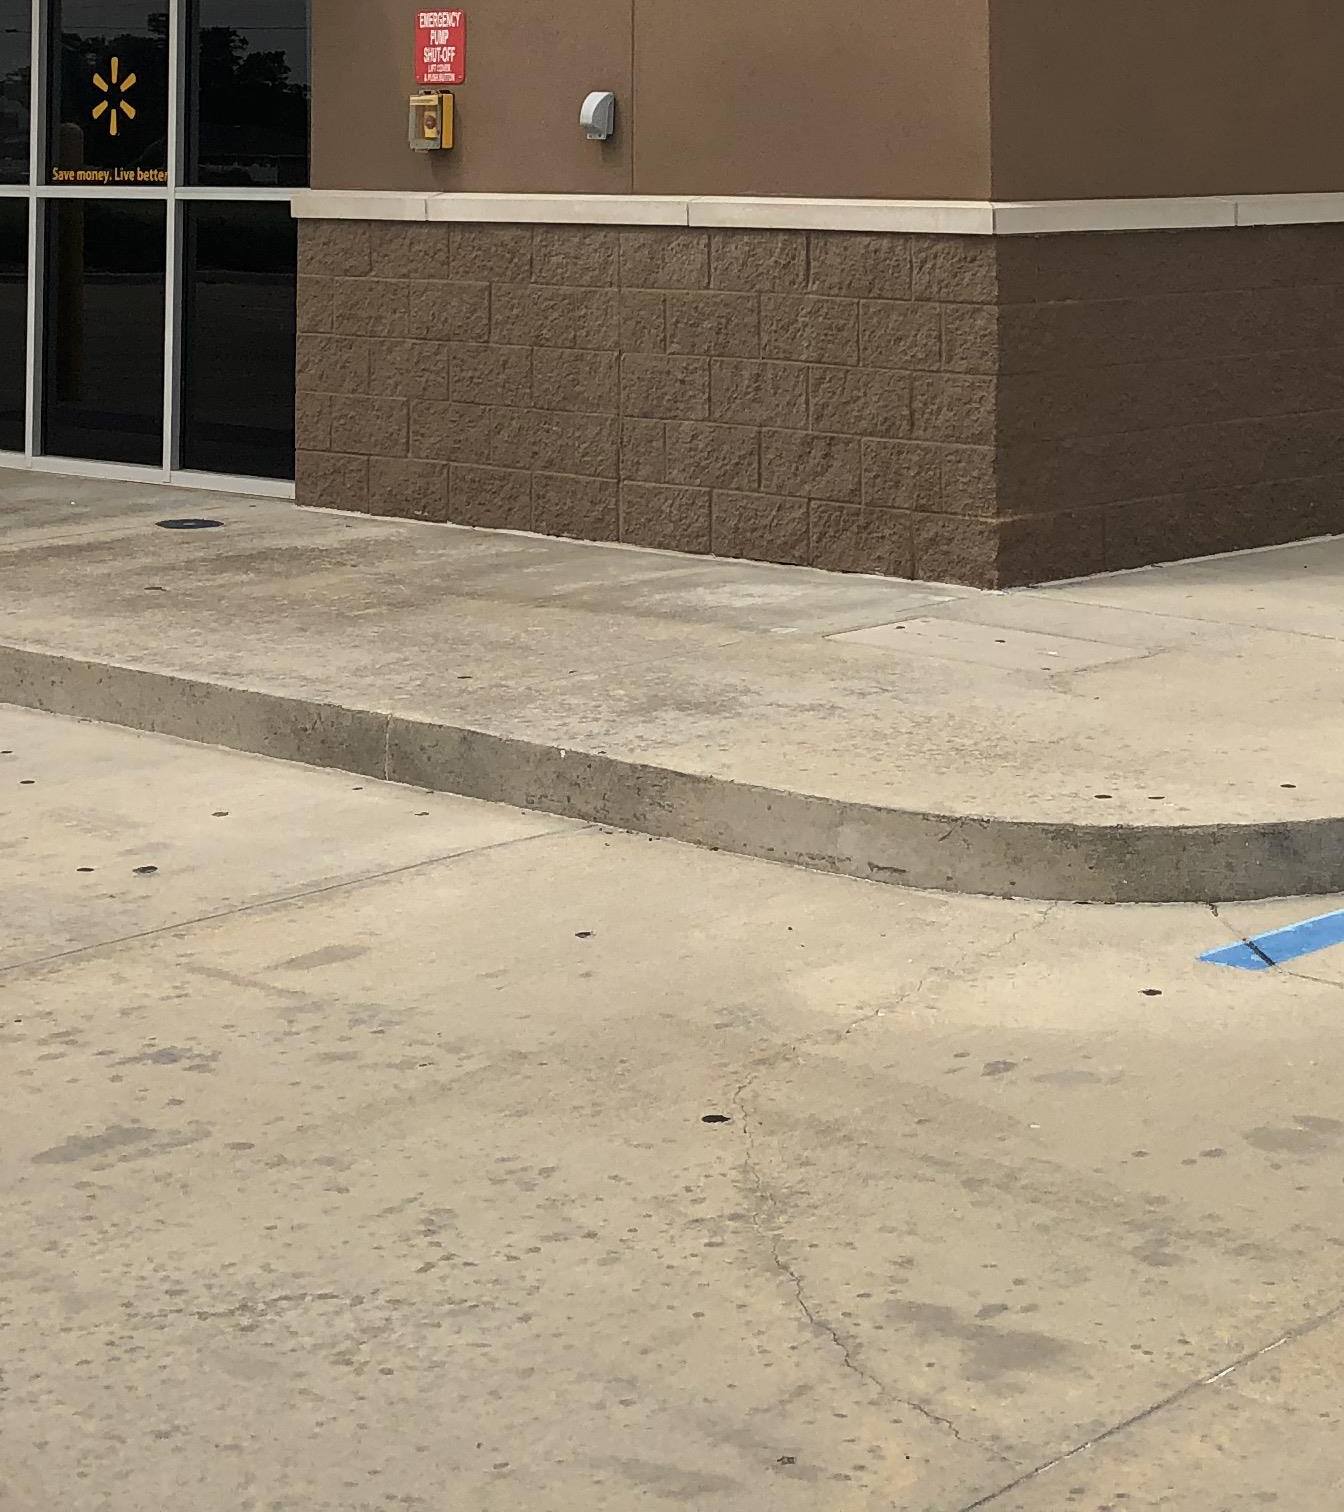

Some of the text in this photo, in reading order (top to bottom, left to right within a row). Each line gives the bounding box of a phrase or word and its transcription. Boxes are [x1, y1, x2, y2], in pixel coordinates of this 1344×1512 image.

[419, 11, 462, 28] EMERGENCY
[430, 29, 449, 45] PUMP
[423, 46, 456, 63] SHUT-OFF
[52, 167, 75, 180] Save
[76, 169, 112, 184] money.
[114, 167, 135, 181] Live
